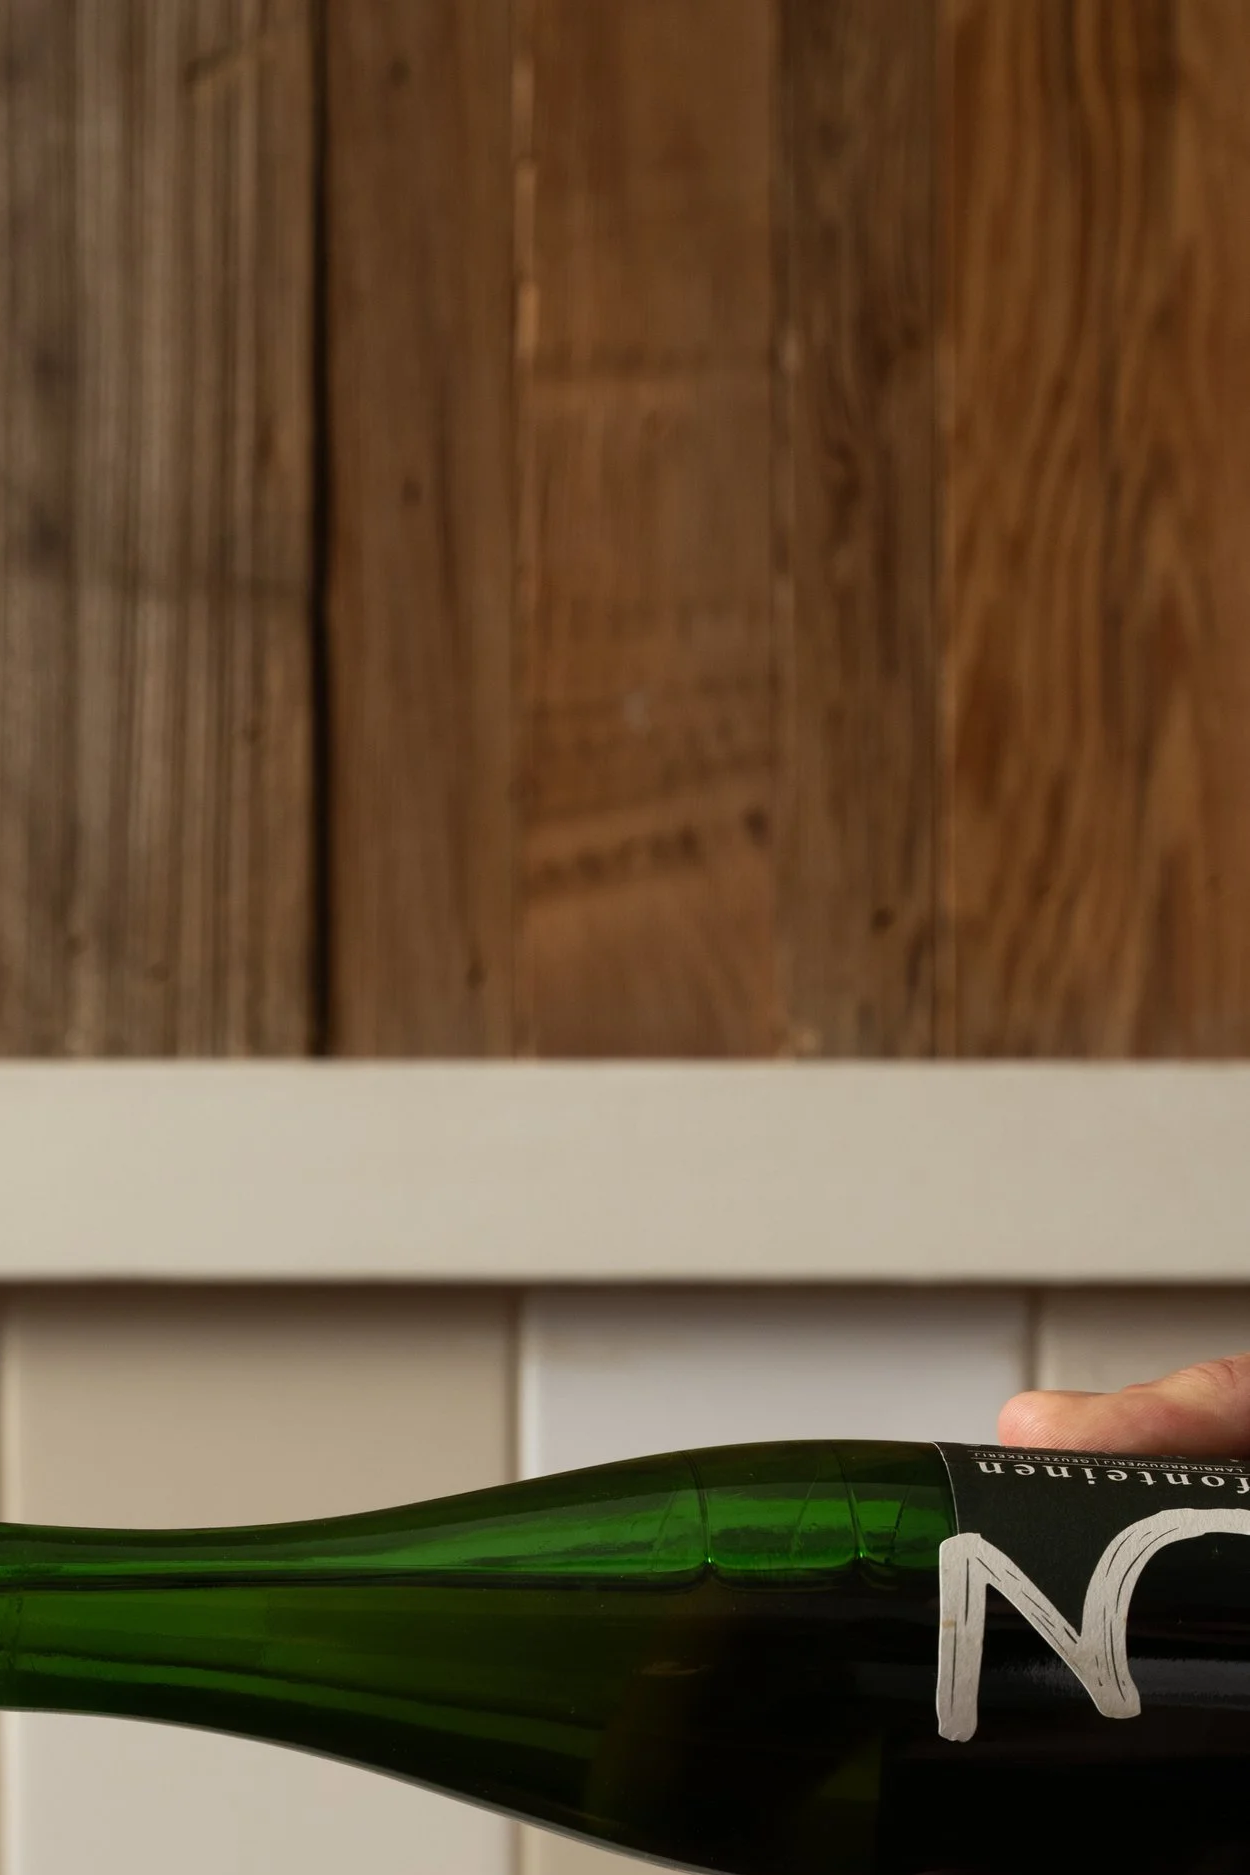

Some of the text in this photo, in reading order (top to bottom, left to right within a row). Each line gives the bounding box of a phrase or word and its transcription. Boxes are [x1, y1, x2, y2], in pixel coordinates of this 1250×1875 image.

[974, 1452, 1244, 1473] LAMBIKBROUWERIJ GEUZESTEKERIJ
[979, 1461, 1250, 1494] fonteinen
